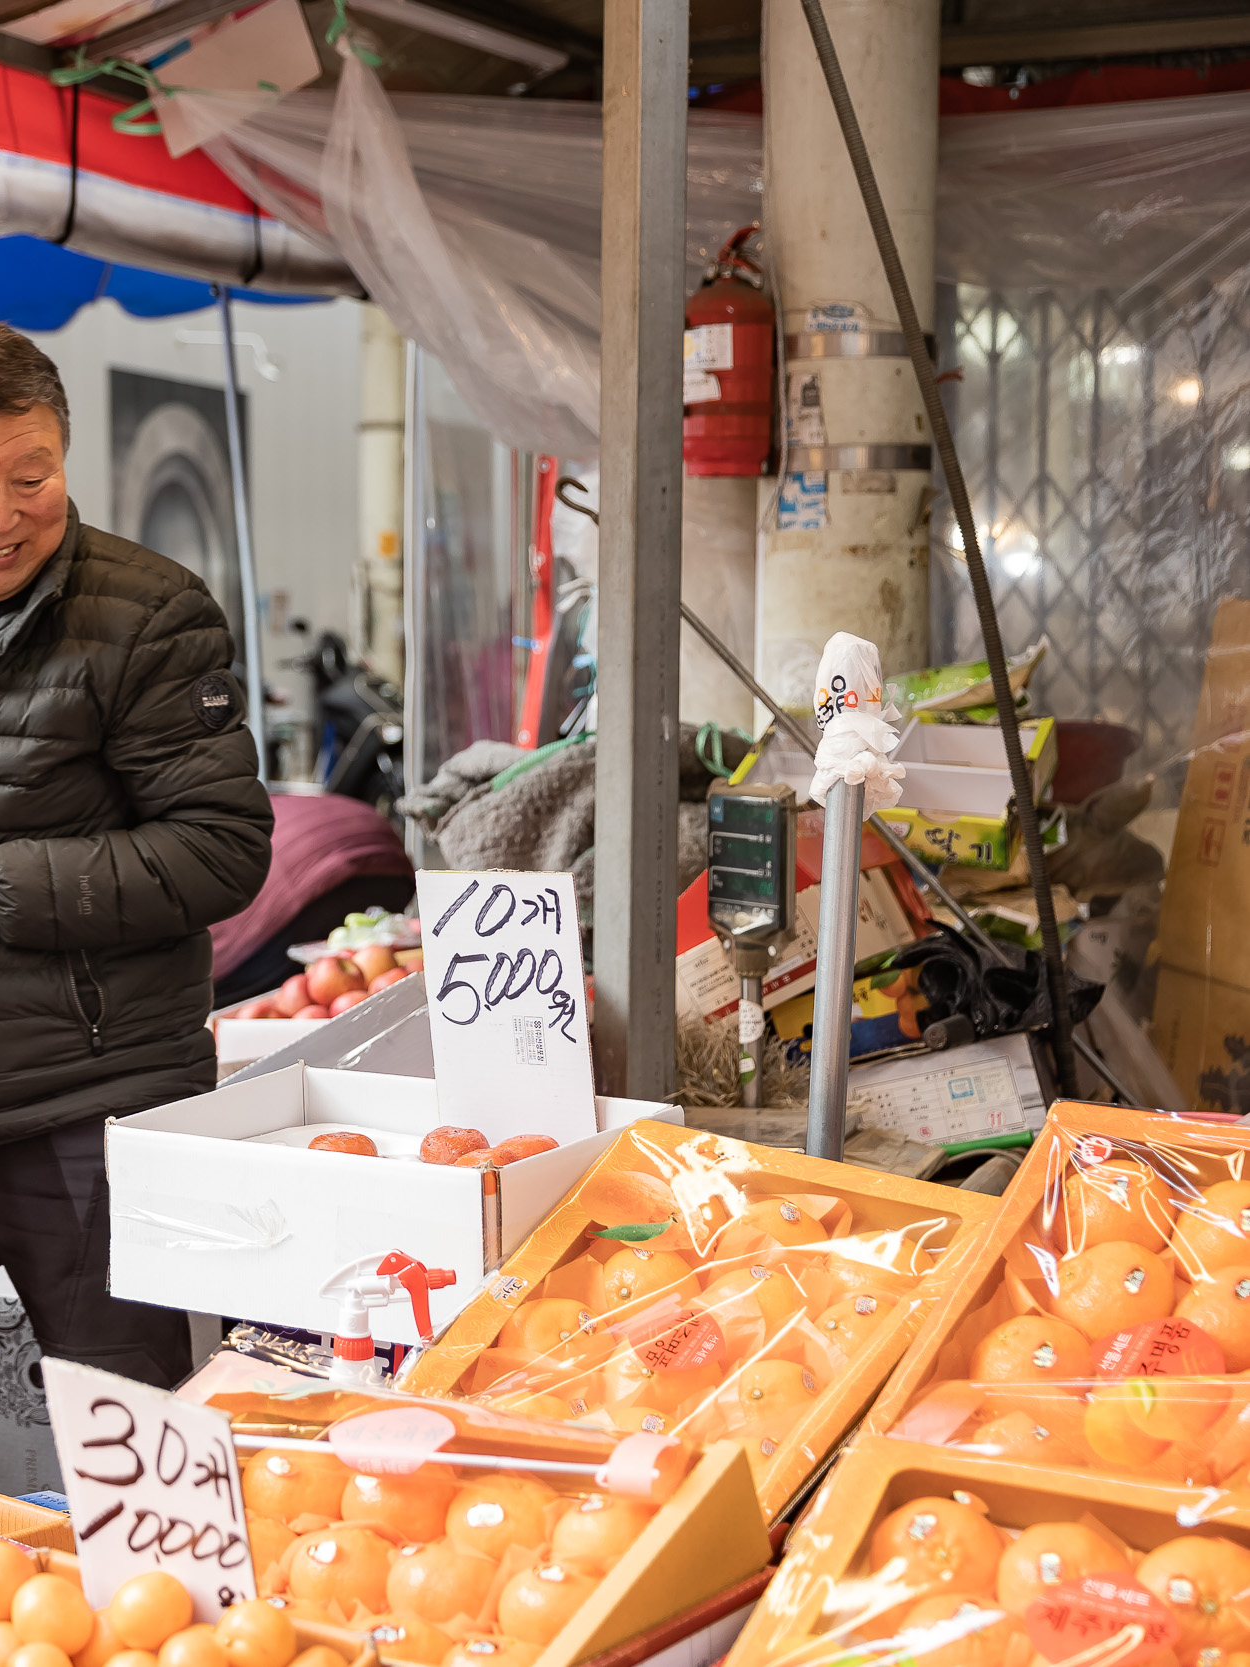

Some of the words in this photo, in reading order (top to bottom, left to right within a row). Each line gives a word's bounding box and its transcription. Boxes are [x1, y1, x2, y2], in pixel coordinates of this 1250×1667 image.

[79, 875, 95, 914] helium
[691, 1334, 720, 1365] 선물세트
[1098, 1332, 1133, 1371] 선물세트
[1082, 1578, 1150, 1607] 선물세트
